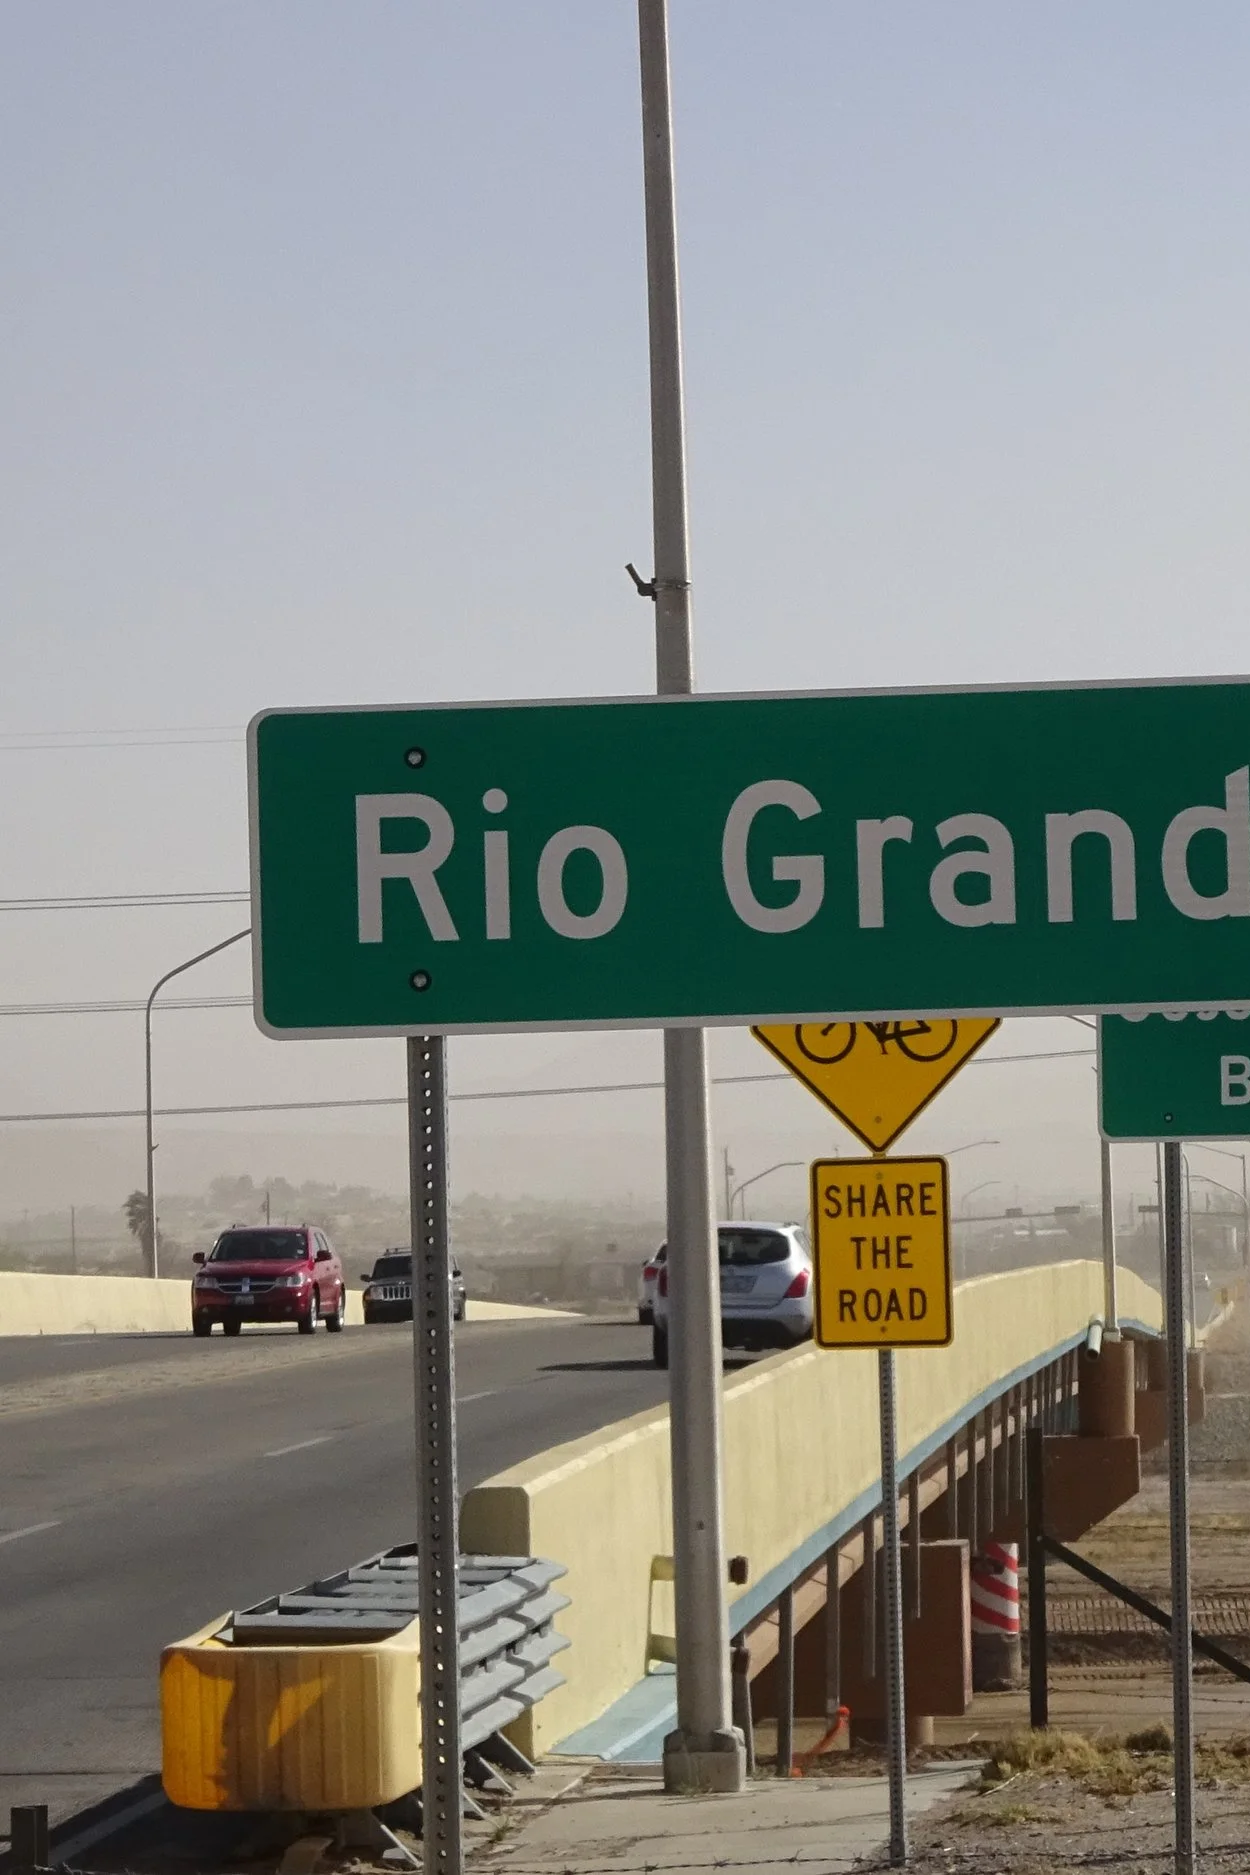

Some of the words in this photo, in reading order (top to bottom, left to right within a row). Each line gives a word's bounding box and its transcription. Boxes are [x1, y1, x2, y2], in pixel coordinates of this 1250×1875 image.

[356, 789, 628, 942] Rio
[823, 1182, 937, 1219] SHARE
[850, 1235, 914, 1270] THE
[838, 1287, 928, 1322] ROAD
